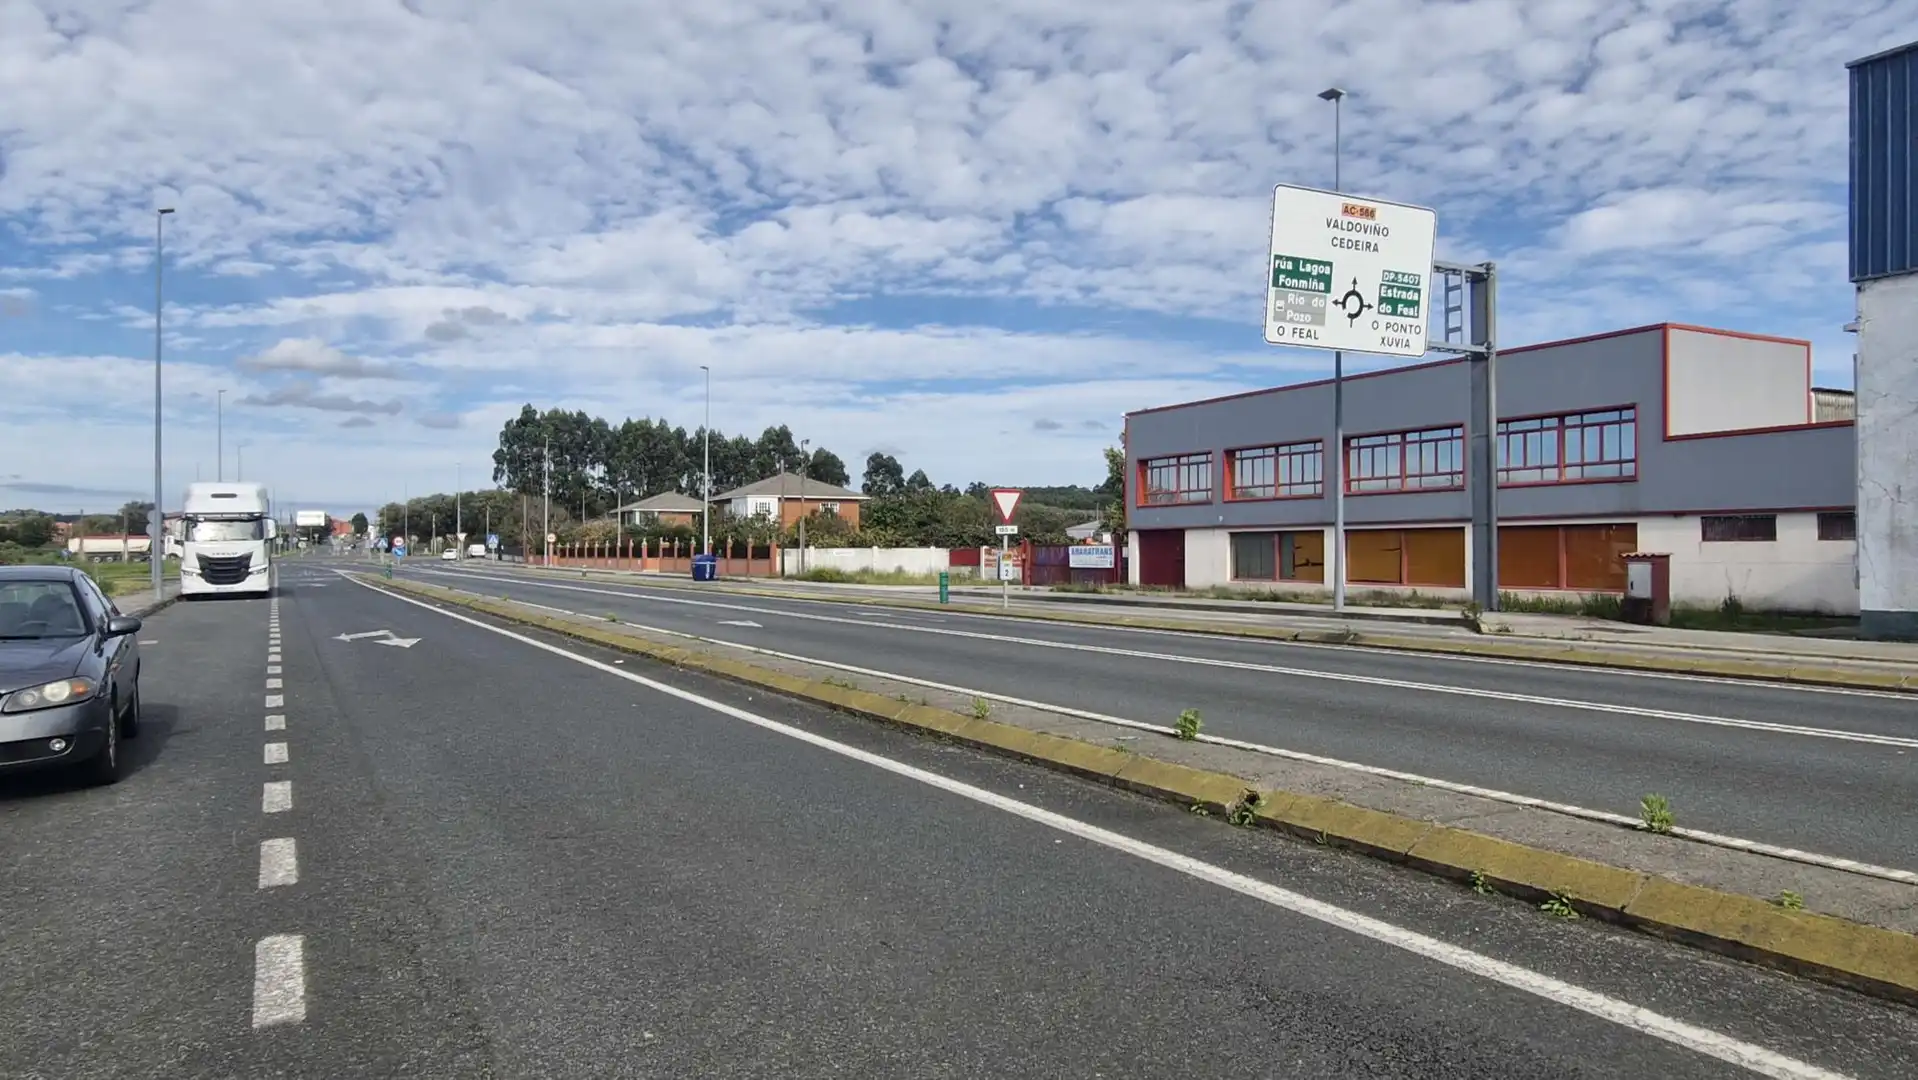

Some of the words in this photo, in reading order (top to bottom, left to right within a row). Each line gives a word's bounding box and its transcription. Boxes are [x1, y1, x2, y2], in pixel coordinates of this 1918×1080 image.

[1343, 205, 1375, 218] AC-566
[1326, 217, 1389, 237] VALDOVIÑO
[1331, 236, 1379, 253] CEDEIRA
[1275, 257, 1292, 270] rúa
[1299, 260, 1330, 275] Lagoa
[1279, 274, 1325, 291] Fonmiña
[1380, 286, 1418, 301] Estrada
[1312, 296, 1325, 308] do
[1379, 301, 1392, 314] do
[1397, 304, 1418, 316] Feal
[1286, 310, 1312, 323] Pozo
[1277, 325, 1285, 336] O
[1292, 327, 1319, 340] FEAL
[1372, 320, 1379, 330] O
[1385, 322, 1422, 335] PONTO
[1380, 336, 1410, 348] XUVIA
